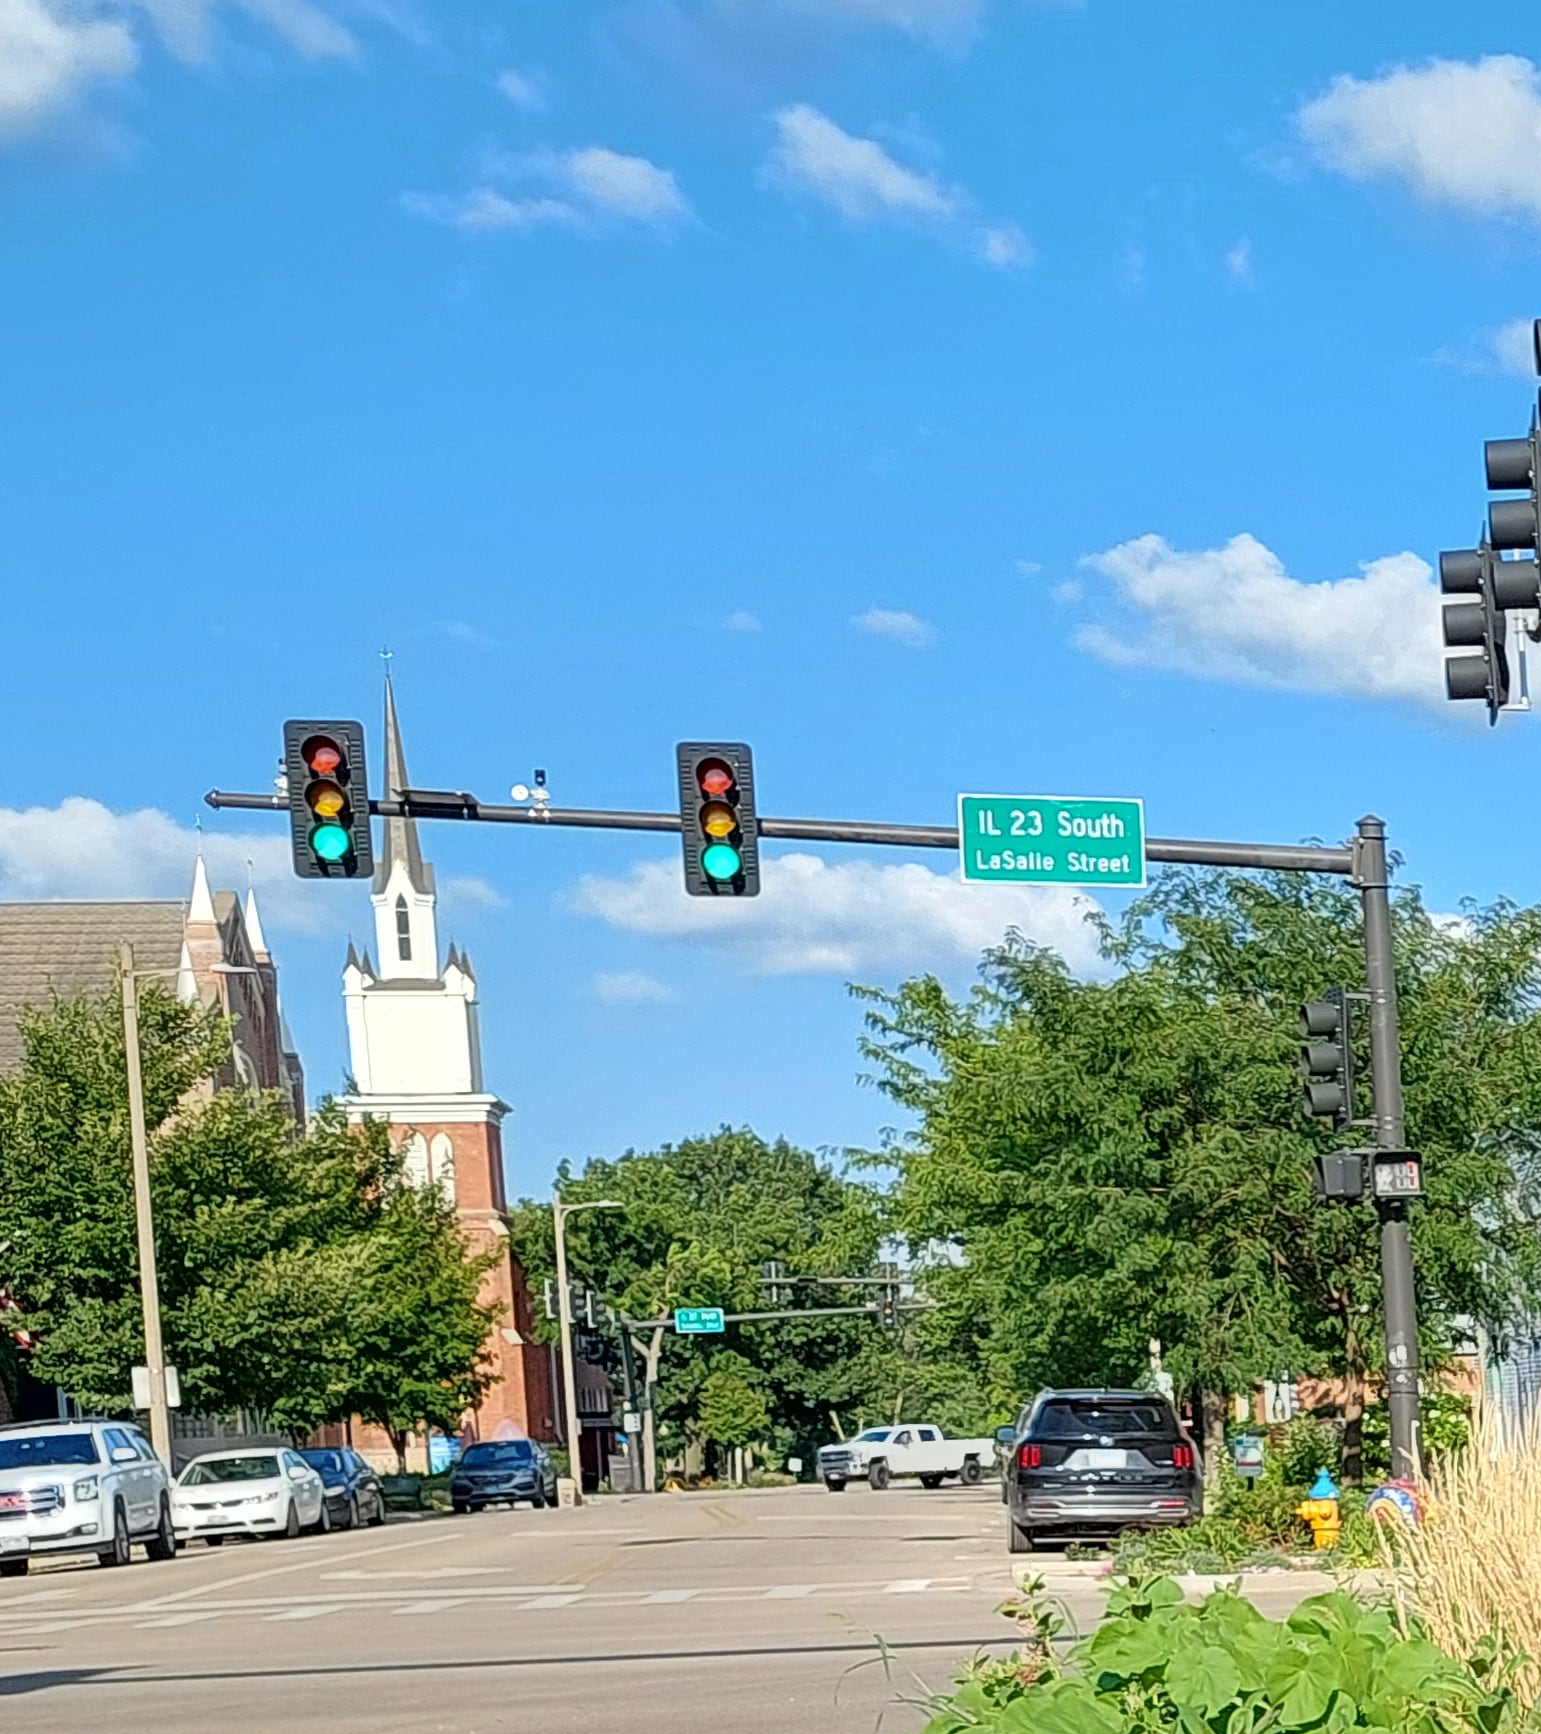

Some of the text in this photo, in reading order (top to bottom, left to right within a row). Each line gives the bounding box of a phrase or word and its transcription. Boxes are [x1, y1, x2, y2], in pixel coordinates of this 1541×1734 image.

[978, 809, 1124, 838] IL 23 South
[976, 849, 1130, 873] LaSalle Street
